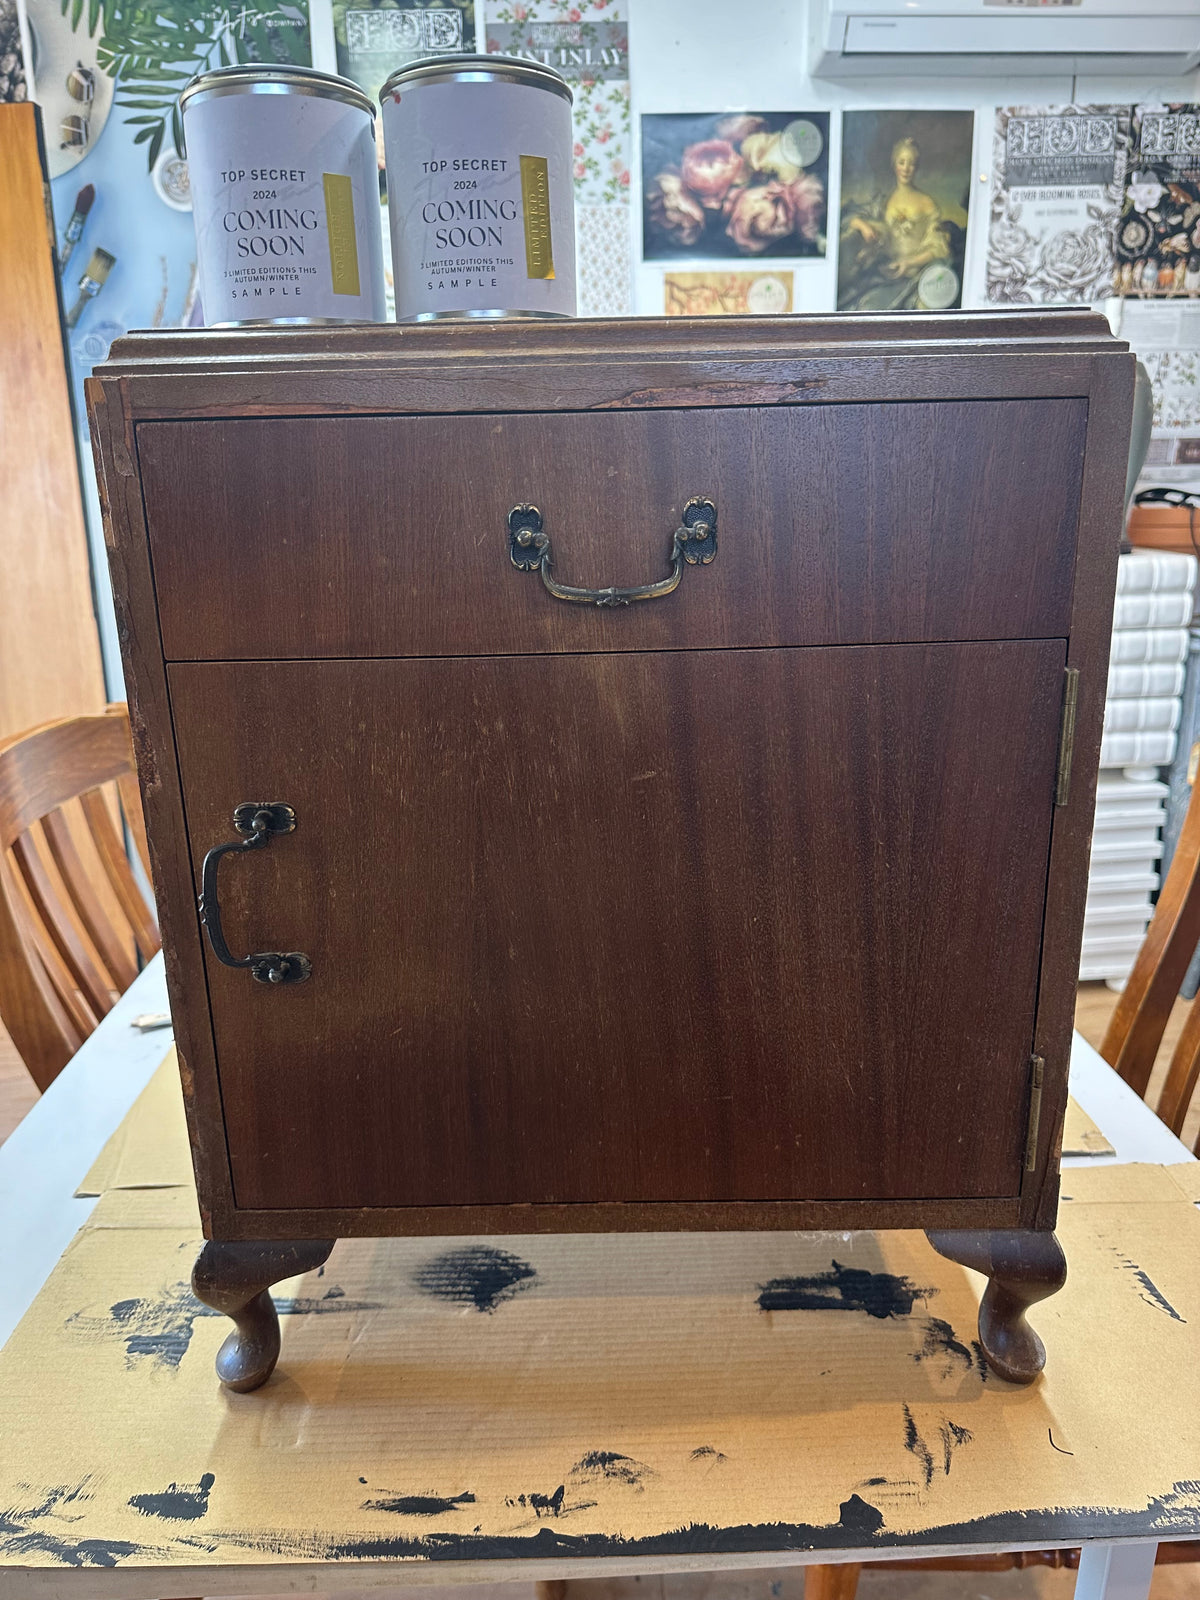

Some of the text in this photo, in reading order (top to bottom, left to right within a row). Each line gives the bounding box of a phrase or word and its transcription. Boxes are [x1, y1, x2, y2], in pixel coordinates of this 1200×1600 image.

[560, 48, 623, 65] INLAY
[422, 159, 507, 174] TOP SECRET
[221, 169, 306, 183] TOP SECRET
[453, 180, 477, 190] 2024
[253, 190, 277, 200] 2024
[422, 199, 517, 224] COMING
[536, 171, 549, 239] EDITION
[223, 209, 318, 233] COMING
[436, 226, 503, 249] SOON
[237, 235, 305, 258] SOON
[425, 259, 454, 269] LIMITED
[456, 258, 493, 266] EDITIONS
[431, 266, 496, 275] AUTUMN/WINTER
[228, 267, 256, 277] LIMITED
[259, 266, 296, 275] EDITIONS
[299, 266, 317, 274] THIS
[234, 274, 300, 284] AUTUMN/WINTER
